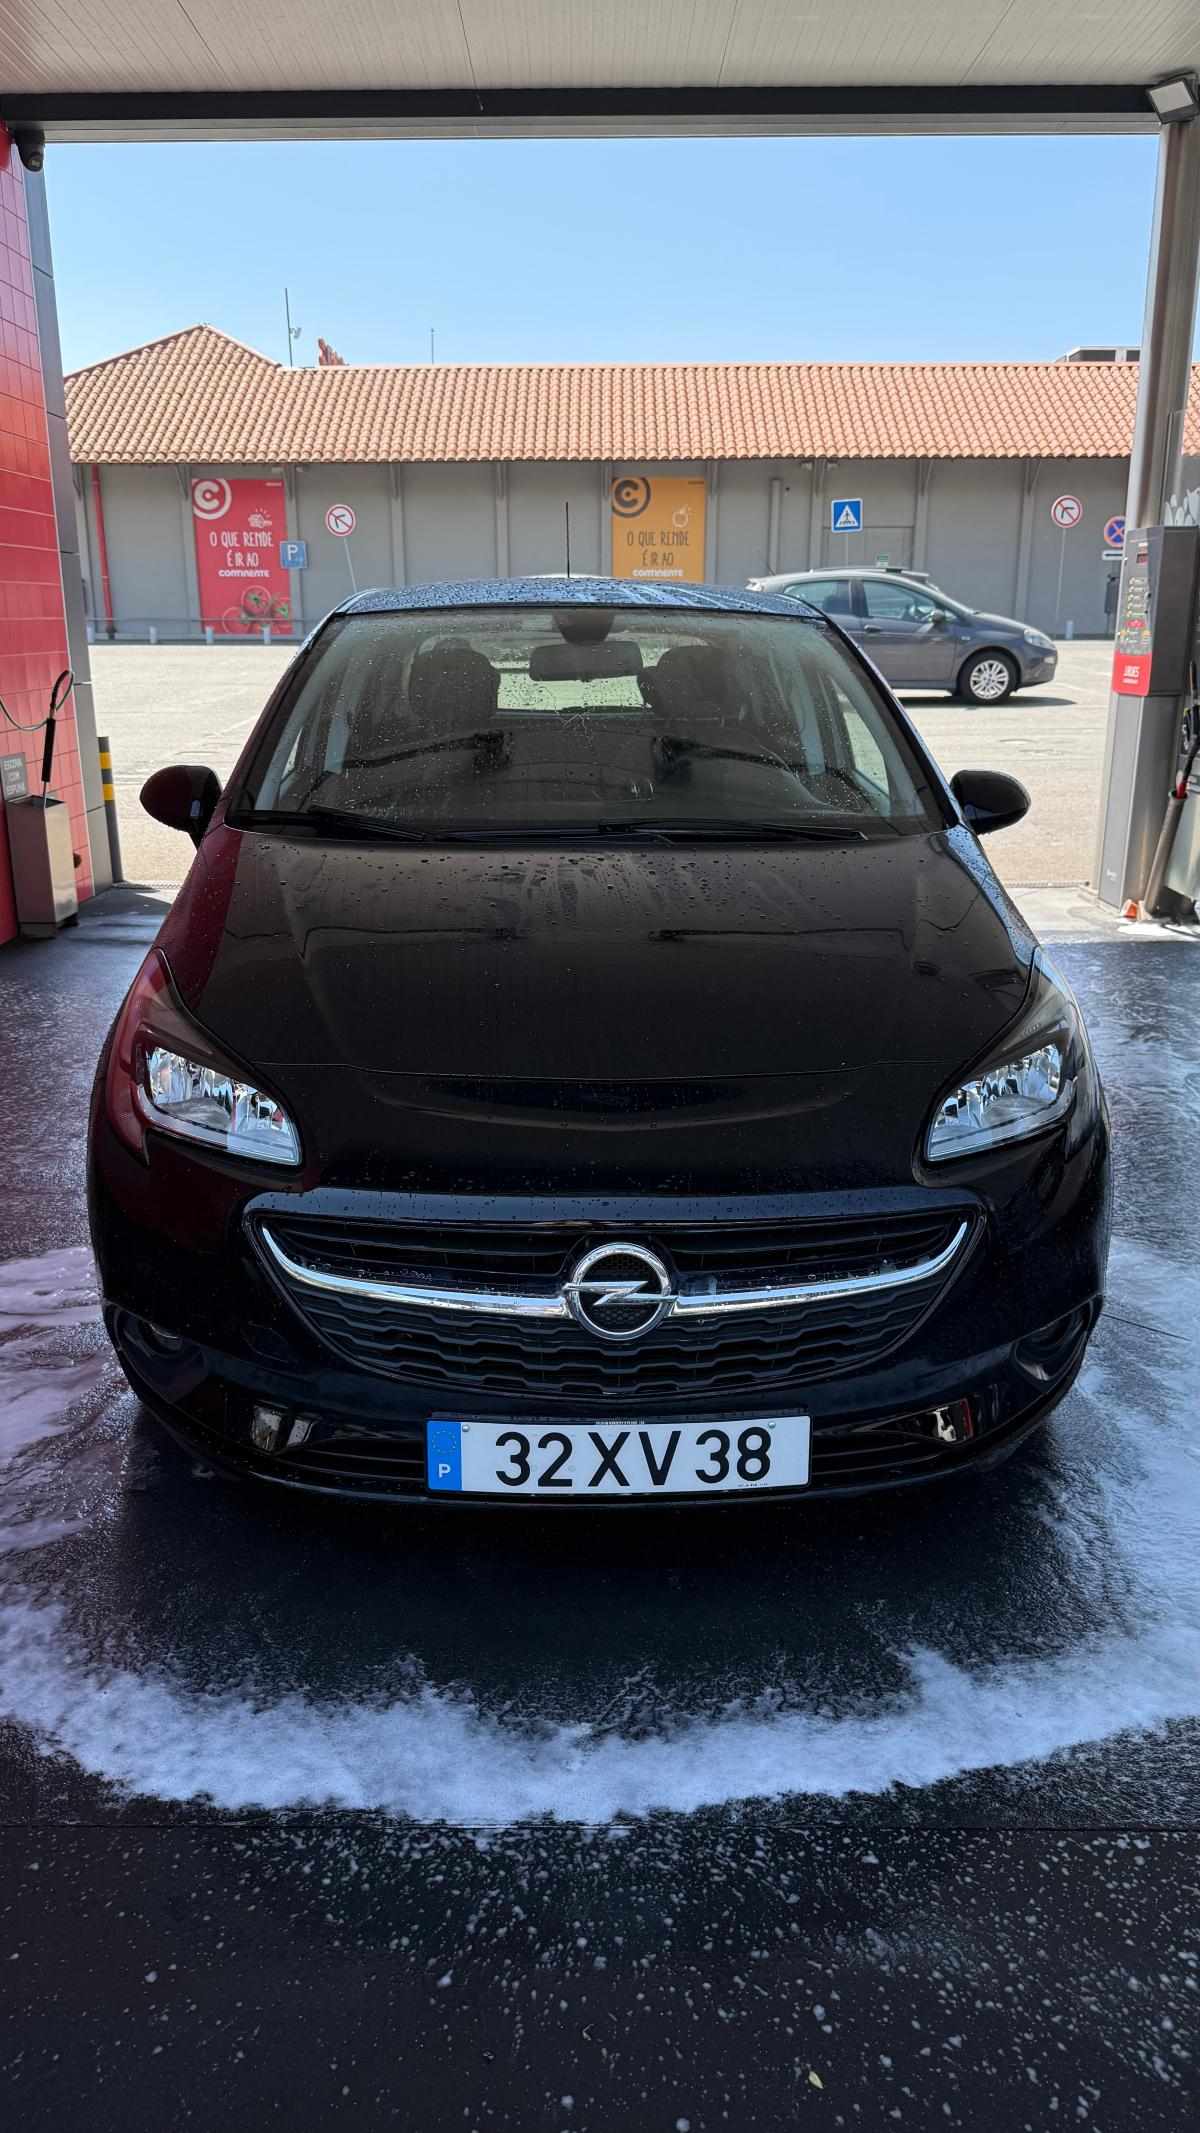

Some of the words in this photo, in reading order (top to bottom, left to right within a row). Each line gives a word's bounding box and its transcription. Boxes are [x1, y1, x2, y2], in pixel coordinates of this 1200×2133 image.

[209, 531, 217, 546] O
[221, 531, 240, 548] QUE
[243, 531, 273, 547] RENDE
[627, 531, 634, 546] O
[638, 531, 656, 547] QUE
[660, 531, 689, 546] RENDE
[227, 549, 234, 567] É
[235, 552, 245, 567] IR
[246, 552, 259, 567] AO
[287, 544, 298, 561] P
[662, 551, 674, 566] AO
[495, 1431, 573, 1487] 32
[587, 1430, 682, 1487] XV
[694, 1426, 772, 1484] 38
[437, 1463, 451, 1479] P
